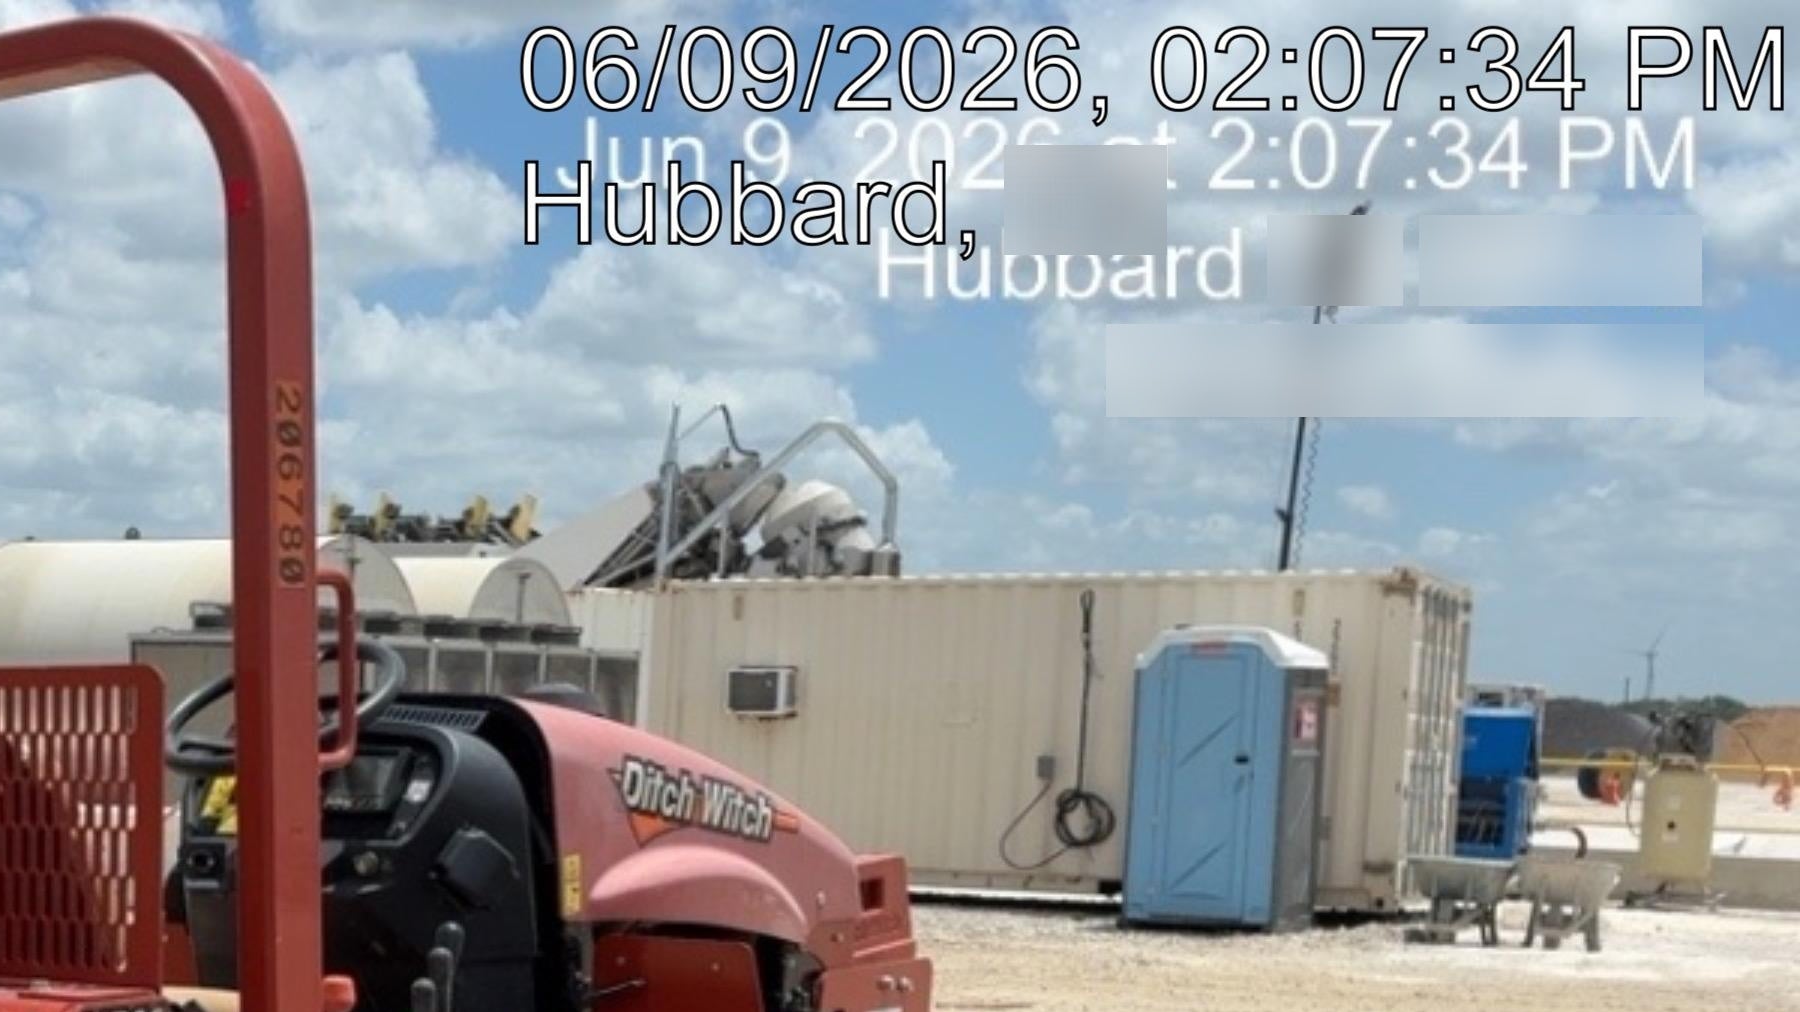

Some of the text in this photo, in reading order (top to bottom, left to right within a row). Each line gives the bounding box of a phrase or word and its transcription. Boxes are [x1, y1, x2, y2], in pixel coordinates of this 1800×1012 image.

[274, 384, 305, 586] 206780
[622, 758, 775, 840] Ditch Witch
